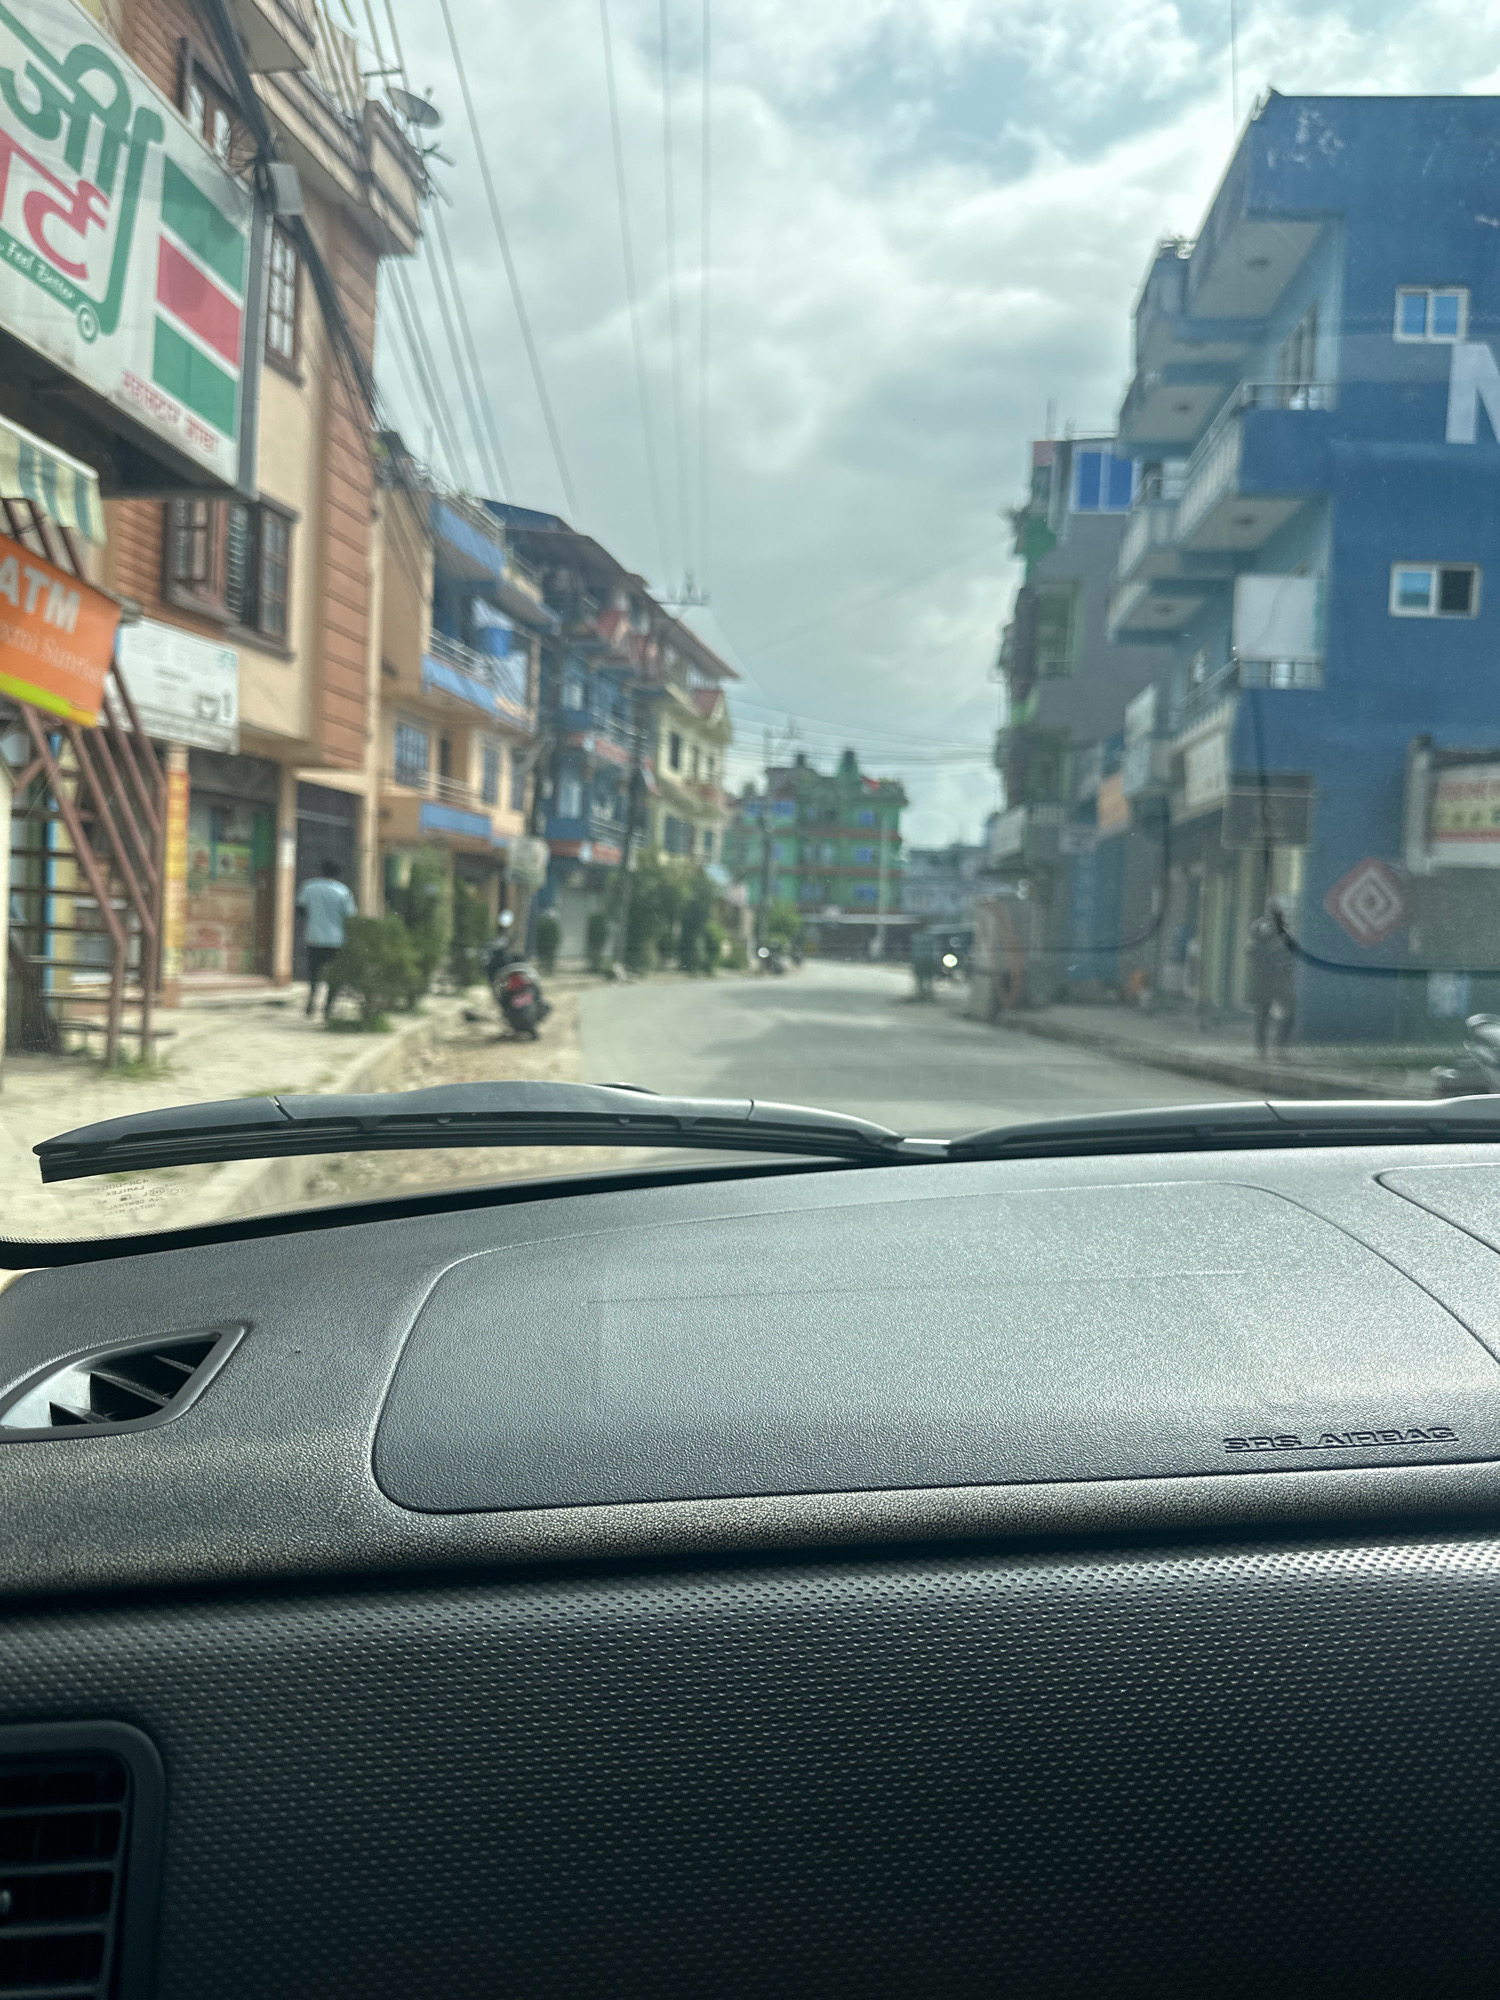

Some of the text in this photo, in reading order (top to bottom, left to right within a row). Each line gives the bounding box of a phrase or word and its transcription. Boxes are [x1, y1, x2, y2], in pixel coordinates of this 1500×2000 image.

[0, 555, 81, 634] ATM
[1223, 1427, 1456, 1451] SRS AIRBAG
